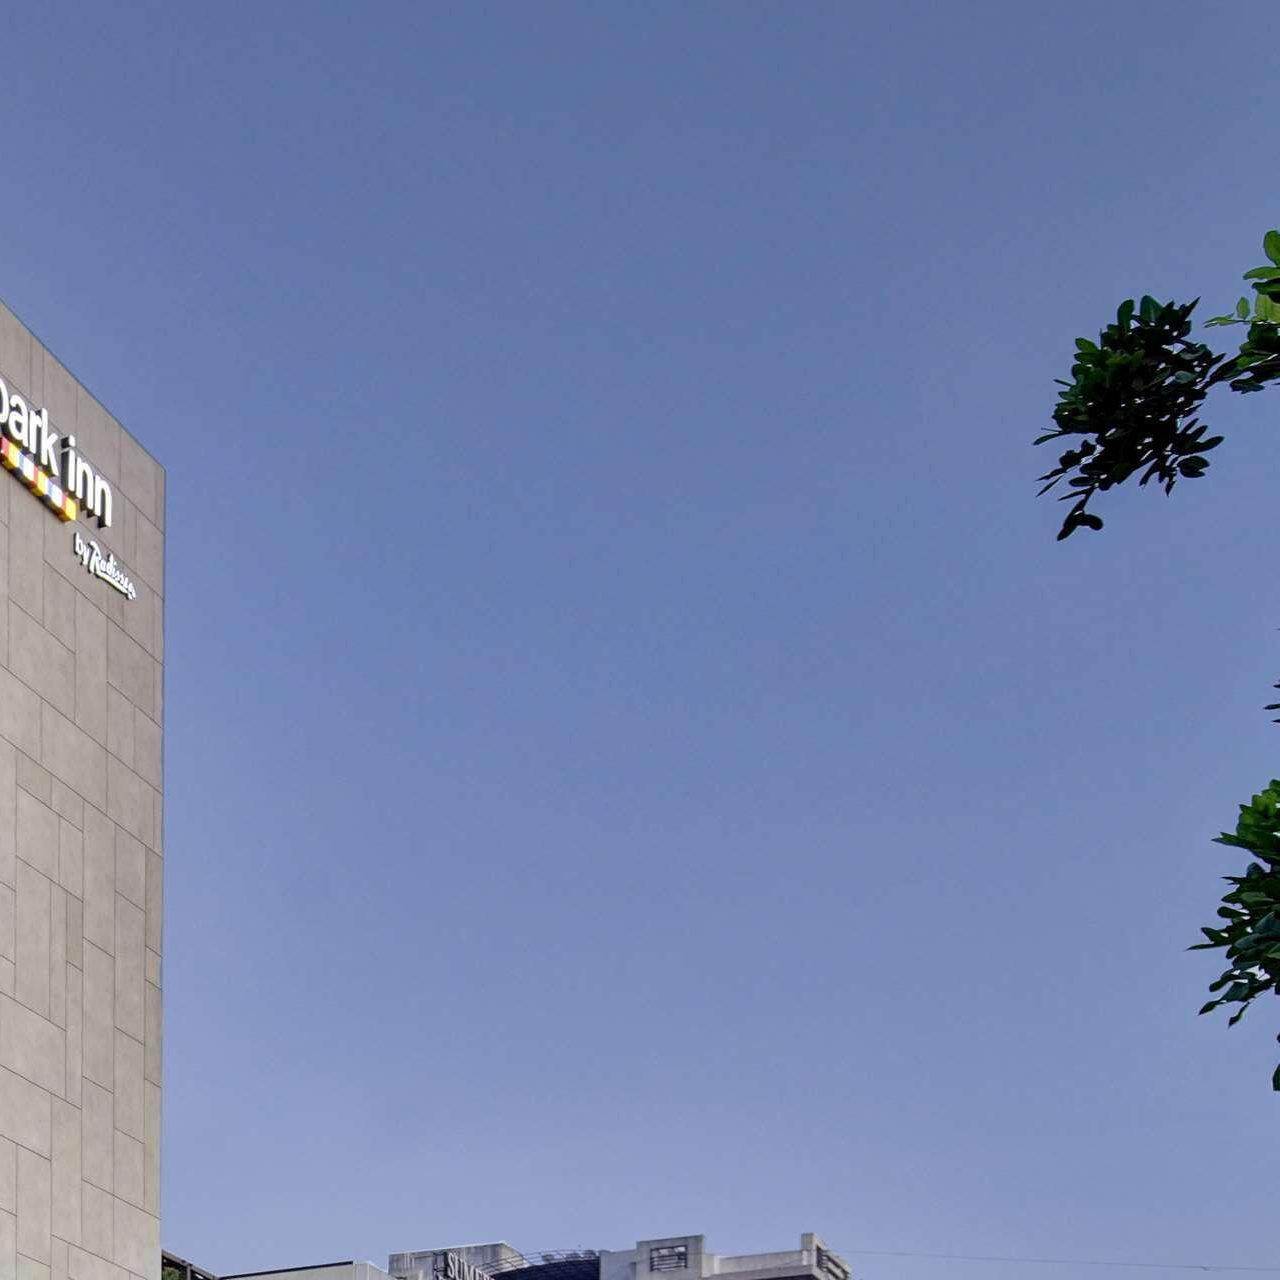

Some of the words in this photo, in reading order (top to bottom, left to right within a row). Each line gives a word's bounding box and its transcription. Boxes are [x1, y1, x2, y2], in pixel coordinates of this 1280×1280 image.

[62, 435, 112, 528] inn
[74, 532, 90, 565] by
[88, 540, 136, 600] Radisson
